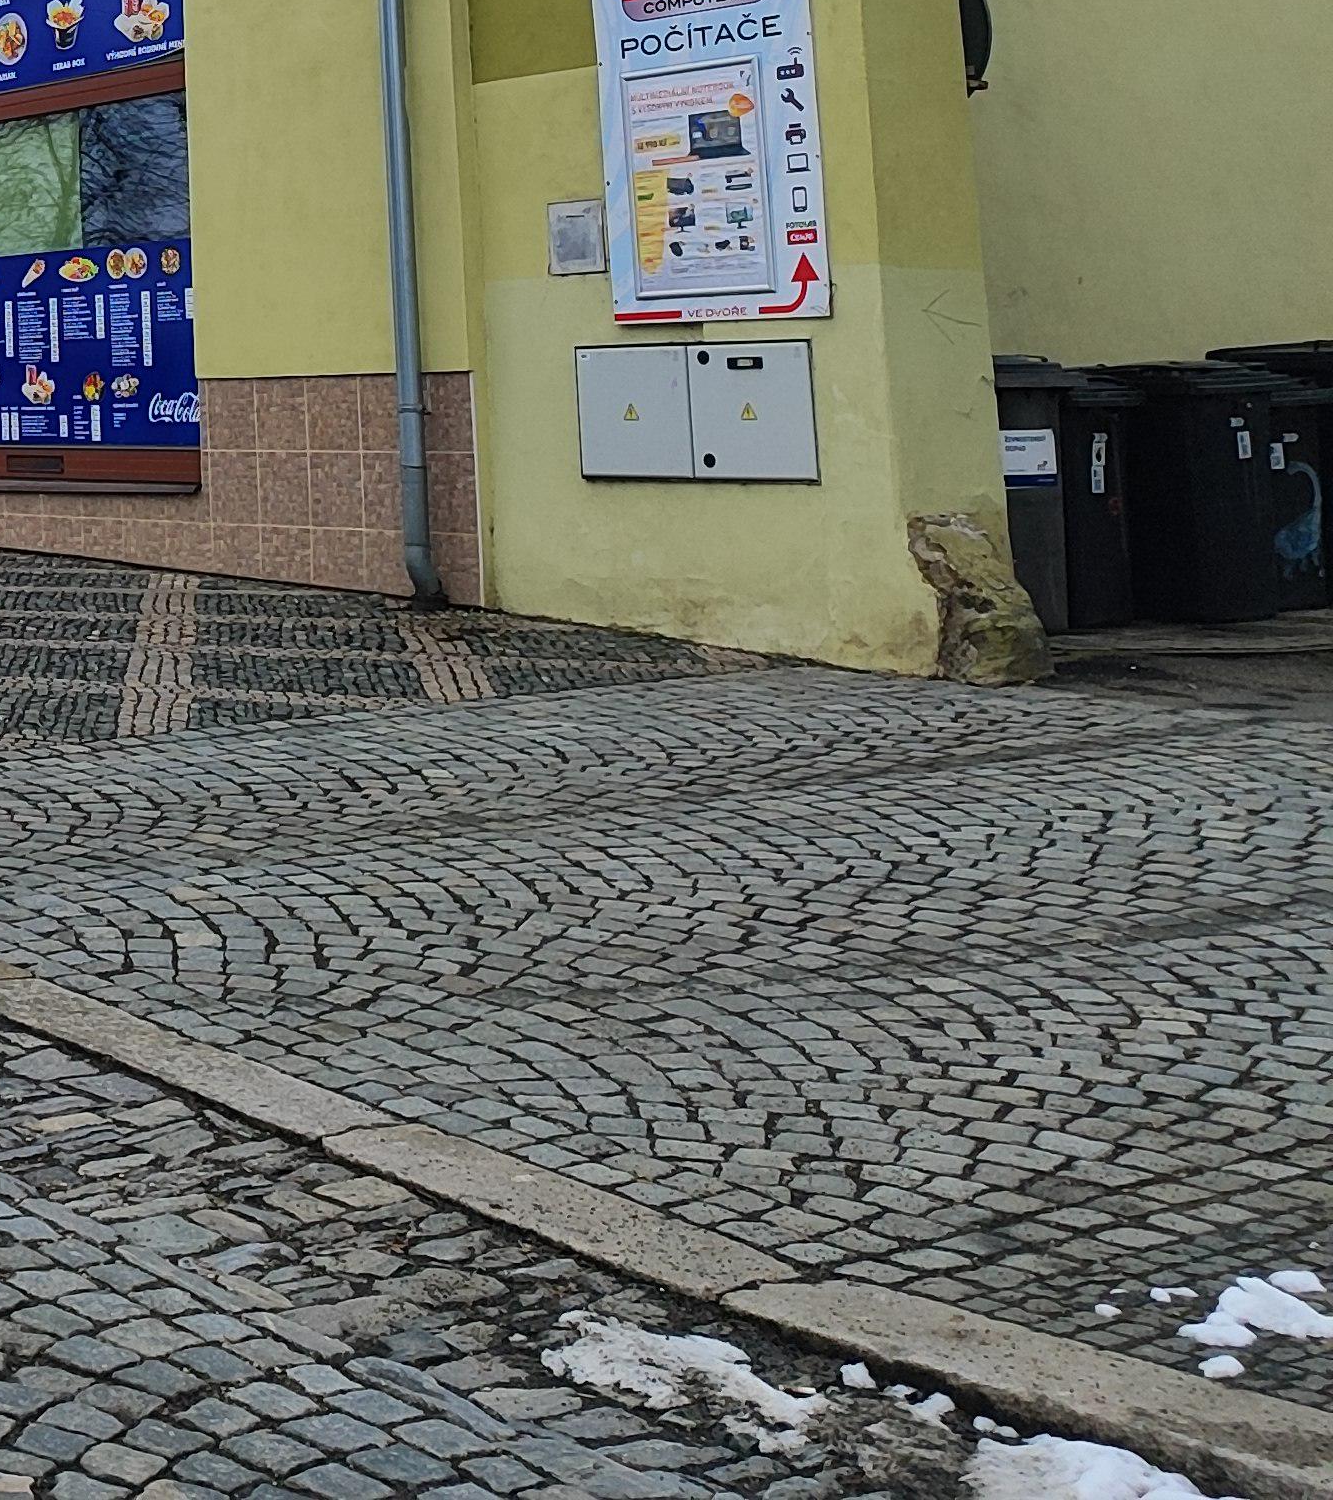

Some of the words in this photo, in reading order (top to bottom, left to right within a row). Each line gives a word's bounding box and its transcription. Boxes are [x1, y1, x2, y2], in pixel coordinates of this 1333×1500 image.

[619, 12, 783, 60] POČÍTAČE
[687, 308, 703, 318] VE
[705, 305, 748, 317] DVOŘE
